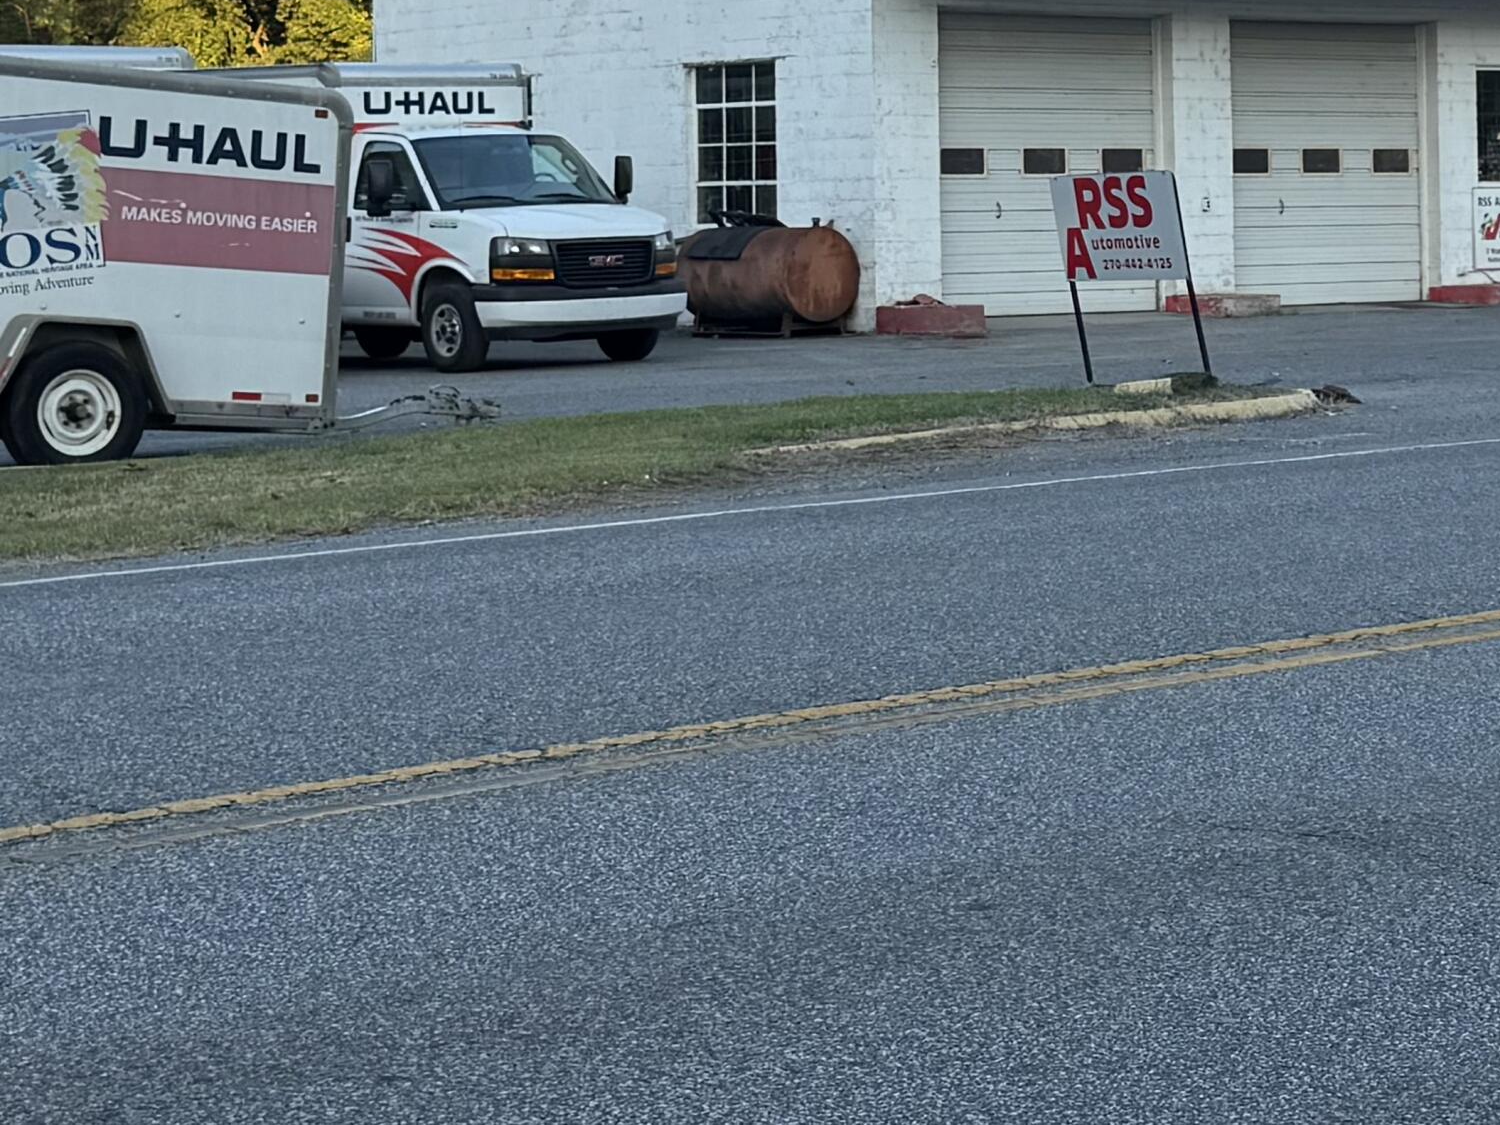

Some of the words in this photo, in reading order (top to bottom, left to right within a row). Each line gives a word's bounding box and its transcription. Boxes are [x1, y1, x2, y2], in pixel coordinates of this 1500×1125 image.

[363, 91, 495, 115] U-HAUL
[99, 115, 321, 174] U-HAUL
[1073, 175, 1153, 230] RSS
[121, 206, 182, 224] MAKES
[187, 210, 256, 230] MOVING
[261, 216, 318, 233] EASIER
[34, 276, 95, 292] Adventure
